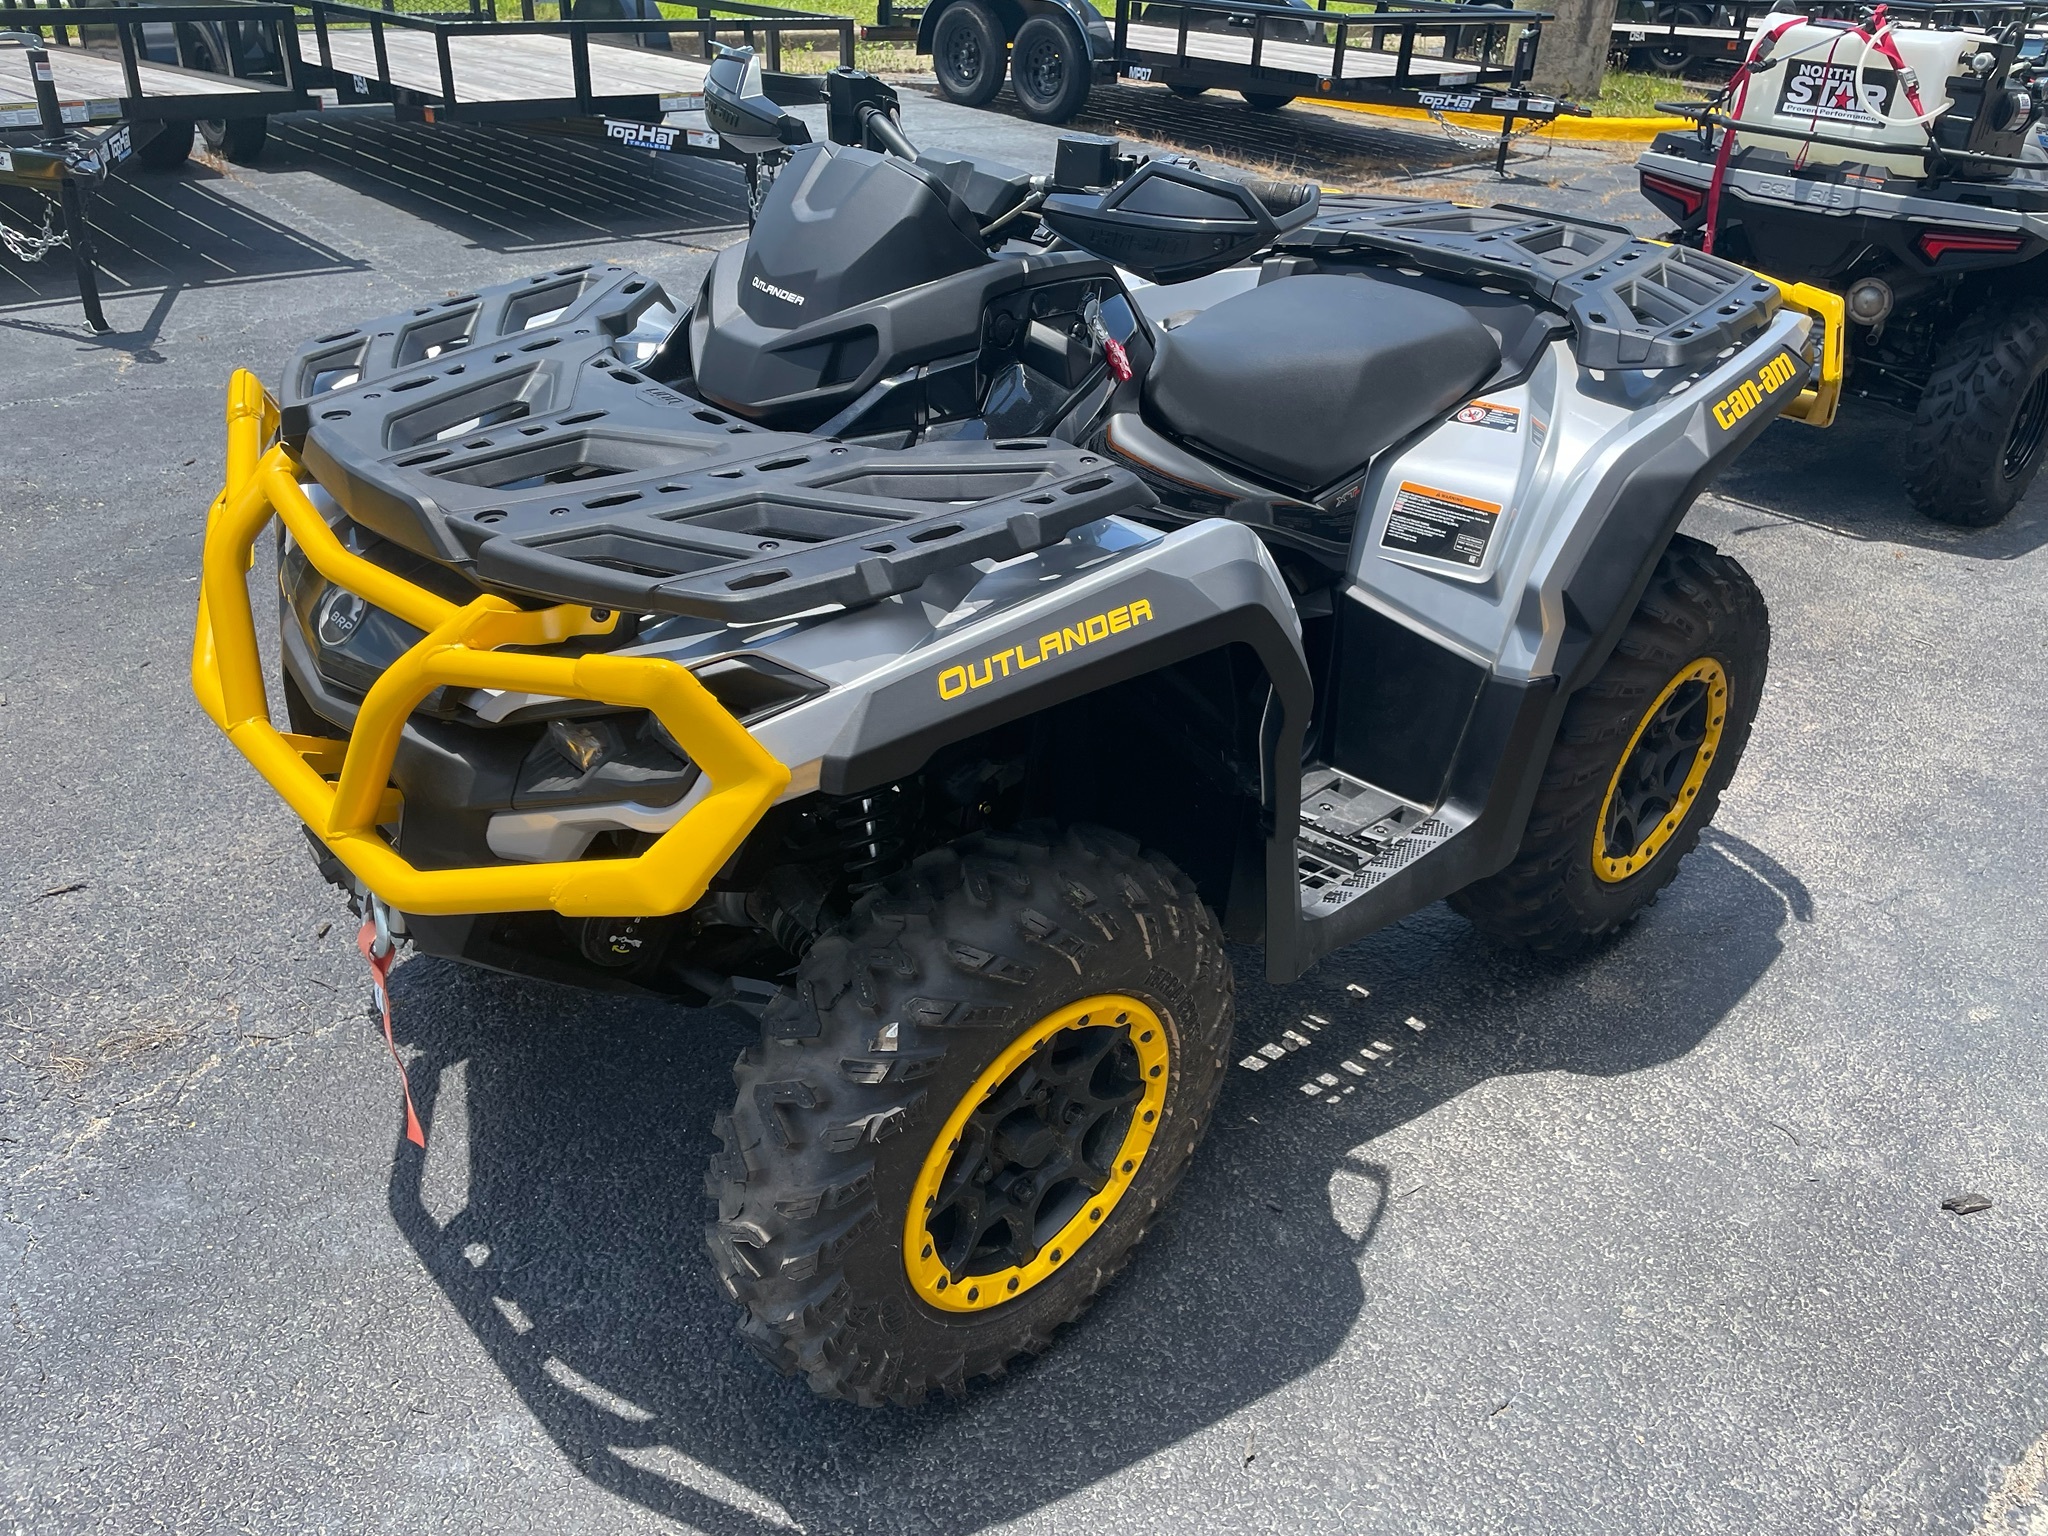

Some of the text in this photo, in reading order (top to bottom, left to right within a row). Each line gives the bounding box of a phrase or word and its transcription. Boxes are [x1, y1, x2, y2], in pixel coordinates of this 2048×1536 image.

[1128, 65, 1152, 81] MP07
[1799, 63, 1855, 81] NORTH
[1786, 75, 1887, 114] STAR
[1786, 104, 1877, 121] Proven Performance
[628, 140, 671, 150] TRAILERS
[751, 276, 805, 306] OUTLANDER
[1712, 352, 1797, 431] can-am
[1440, 494, 1464, 504] WARNING
[330, 611, 353, 630] BRP
[937, 598, 1154, 701] OUTLANDER
